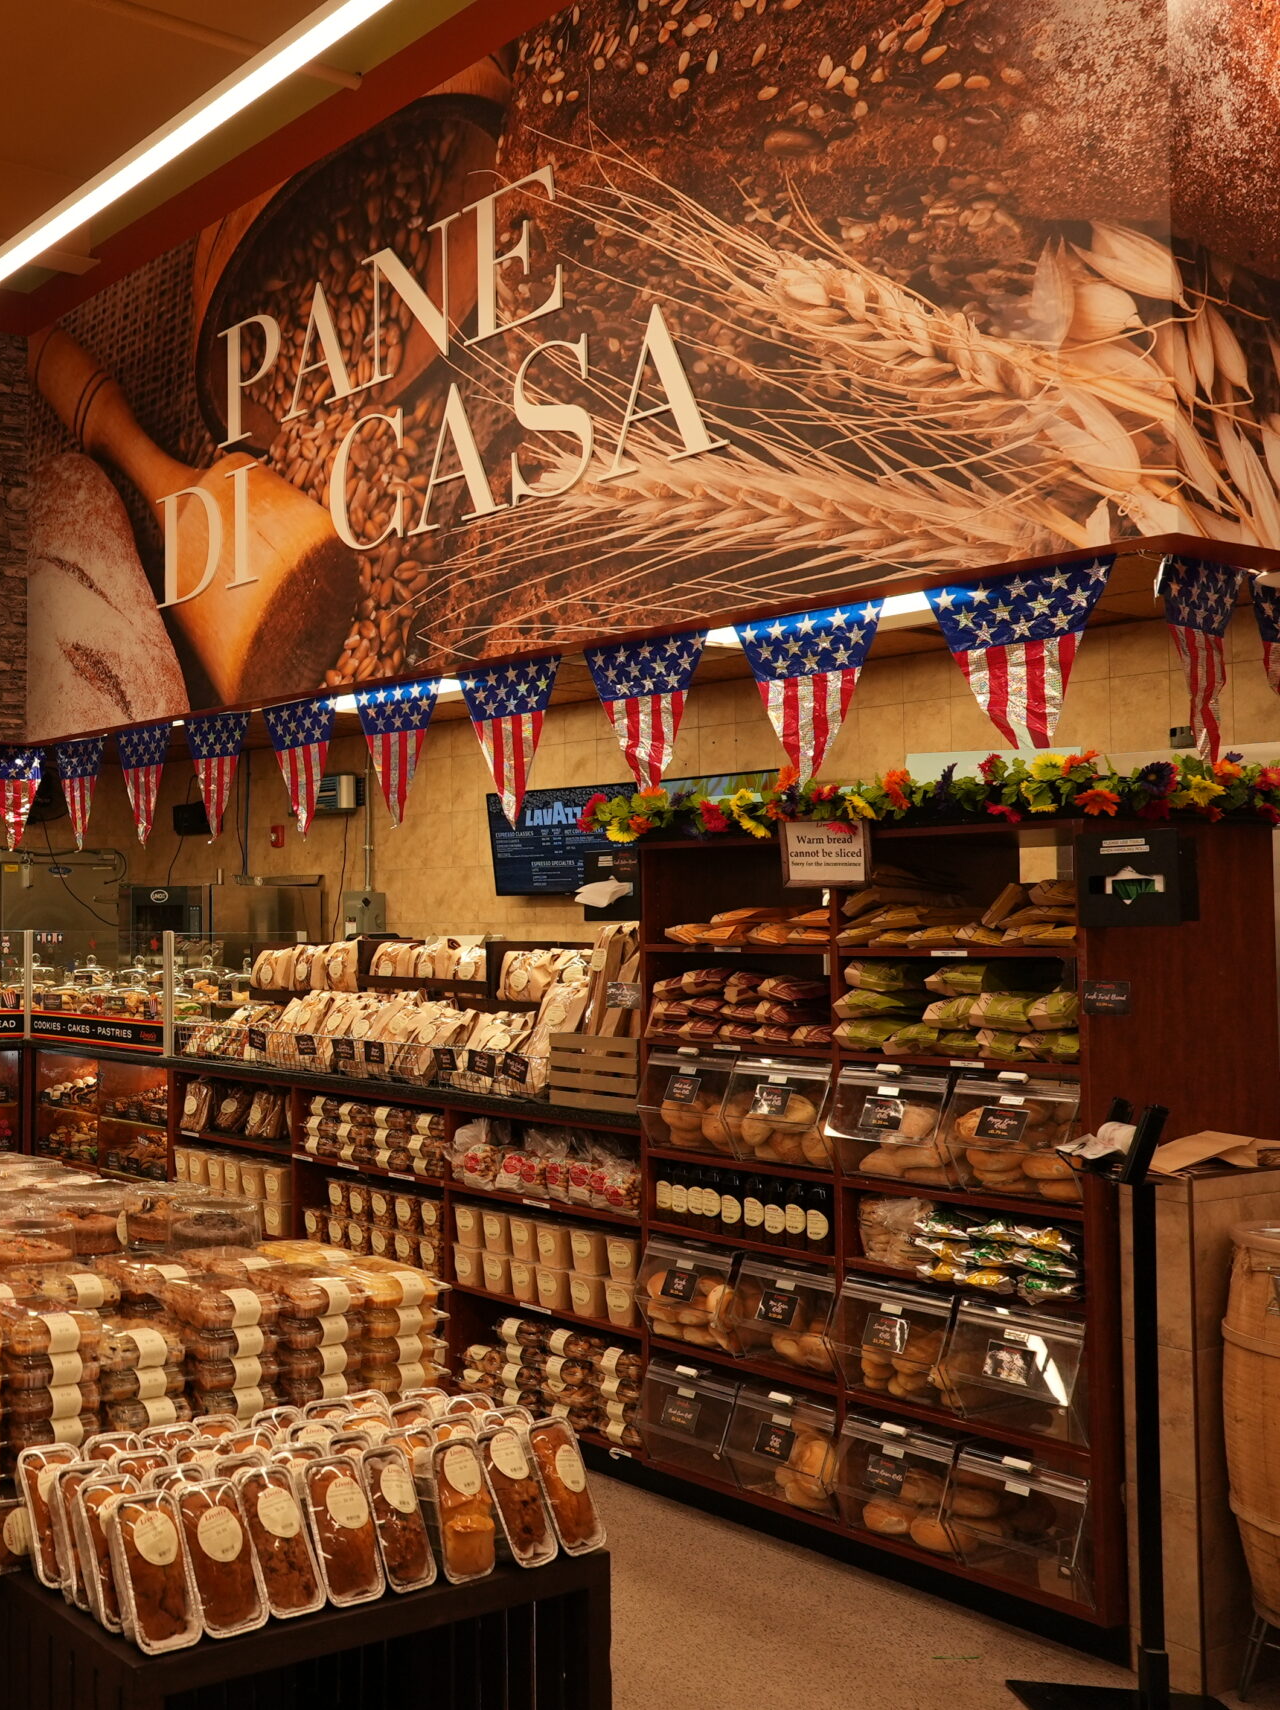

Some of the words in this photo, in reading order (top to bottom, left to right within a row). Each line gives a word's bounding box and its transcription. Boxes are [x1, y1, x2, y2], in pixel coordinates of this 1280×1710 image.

[217, 164, 564, 449] PANE
[156, 461, 260, 609] DI
[329, 303, 731, 551] CASA
[796, 835, 824, 844] Warm
[827, 835, 853, 844] bread
[789, 849, 820, 858] cannot
[822, 848, 832, 858] be
[835, 848, 862, 858] sliced
[33, 1020, 61, 1031] COOKIES
[67, 1023, 90, 1034] CAKES
[97, 1027, 132, 1038] PASTRIES
[204, 1508, 227, 1522] Livoti's
